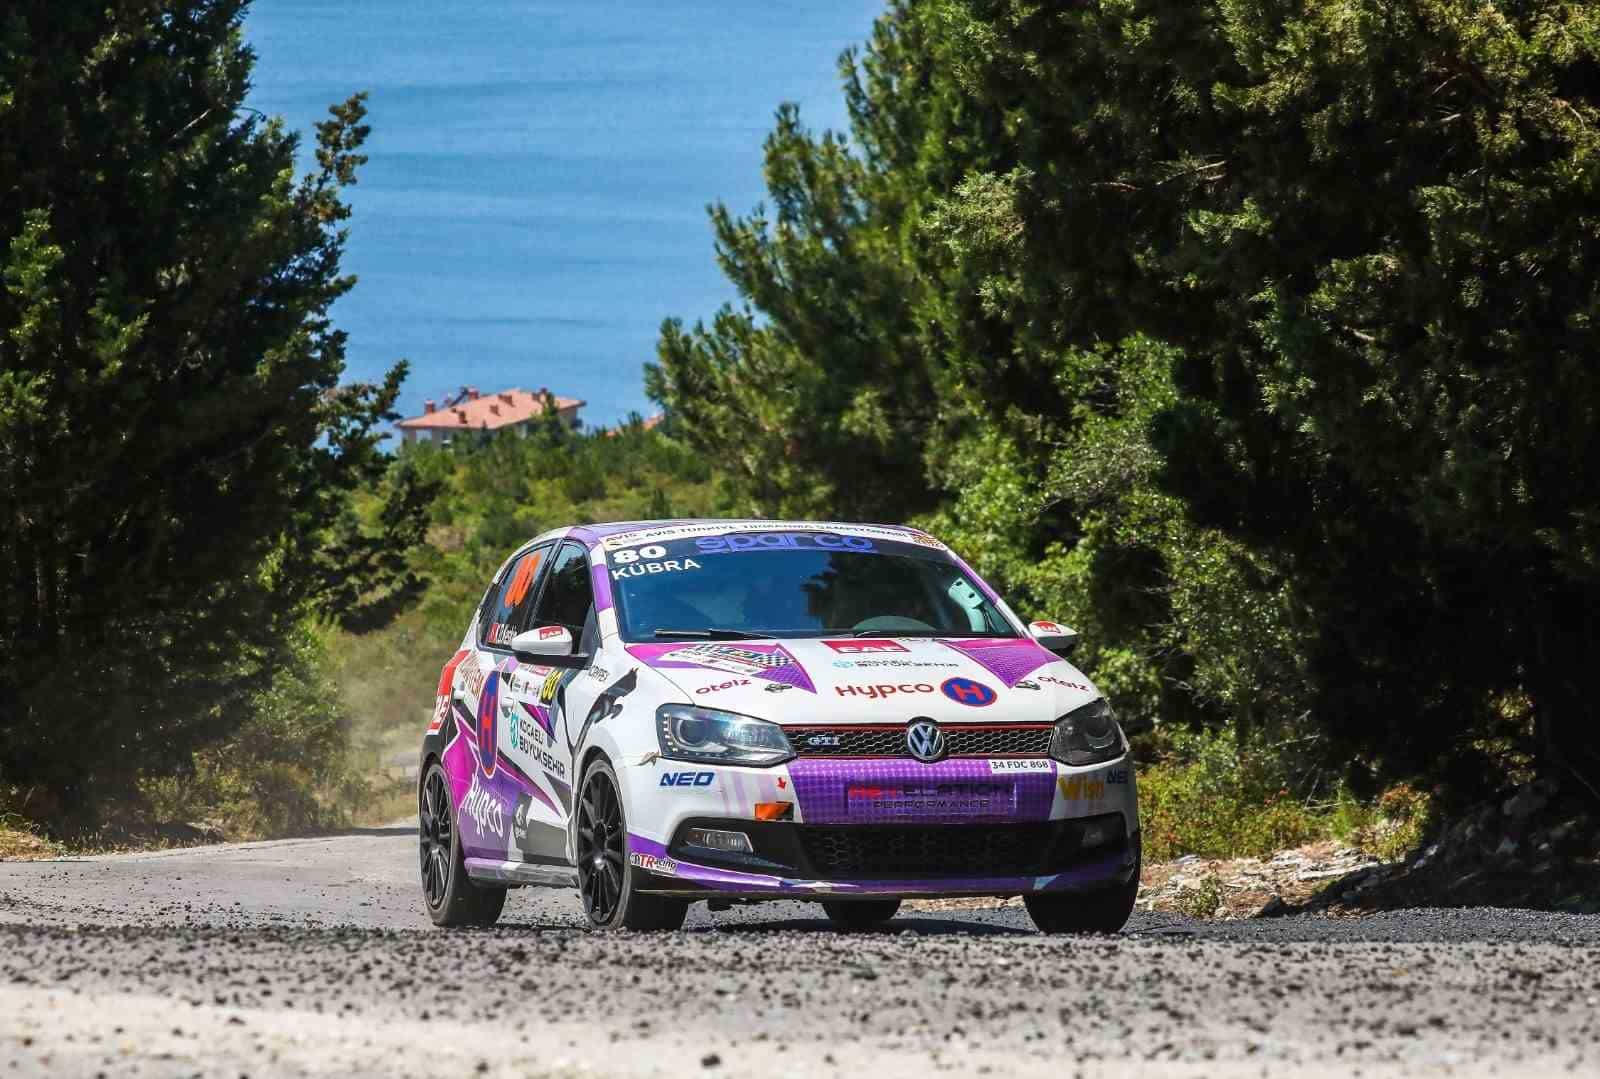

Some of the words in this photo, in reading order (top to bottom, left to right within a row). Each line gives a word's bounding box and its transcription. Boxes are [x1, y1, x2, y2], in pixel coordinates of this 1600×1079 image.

[645, 529, 677, 538] AVIS
[695, 534, 873, 552] sparco
[613, 545, 667, 564] 80
[612, 558, 702, 581] KÜBRA
[695, 678, 752, 695] otelz
[835, 683, 935, 698] Hypco
[951, 684, 986, 701] H
[807, 735, 841, 746] GTI
[991, 761, 1006, 769] 34
[1007, 760, 1028, 769] FDC
[659, 771, 716, 786] NEO
[1105, 768, 1130, 784] NE
[873, 799, 992, 808] PERFORMANCE
